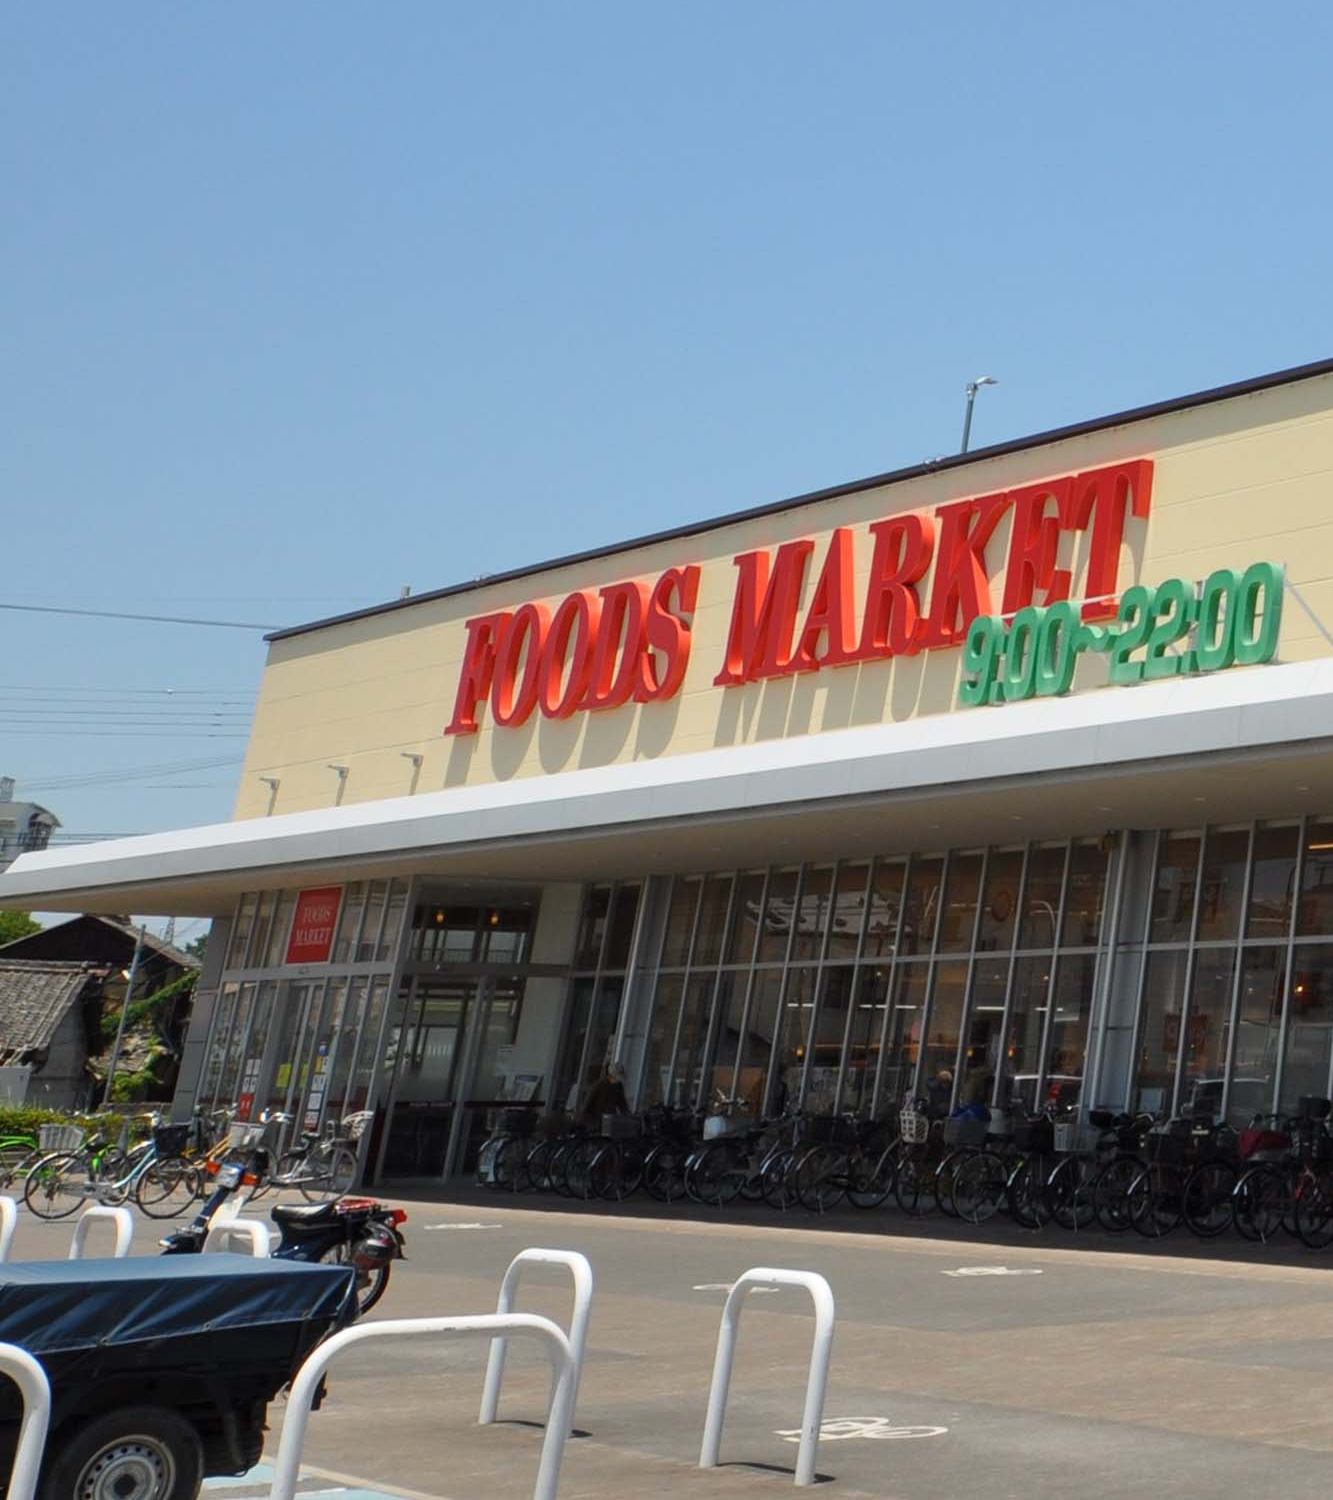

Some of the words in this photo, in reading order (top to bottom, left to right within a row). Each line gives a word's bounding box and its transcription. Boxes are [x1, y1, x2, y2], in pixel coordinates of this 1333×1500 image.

[444, 564, 702, 736] FOODS
[713, 460, 1154, 687] MARKET
[296, 927, 332, 946] MARKET
